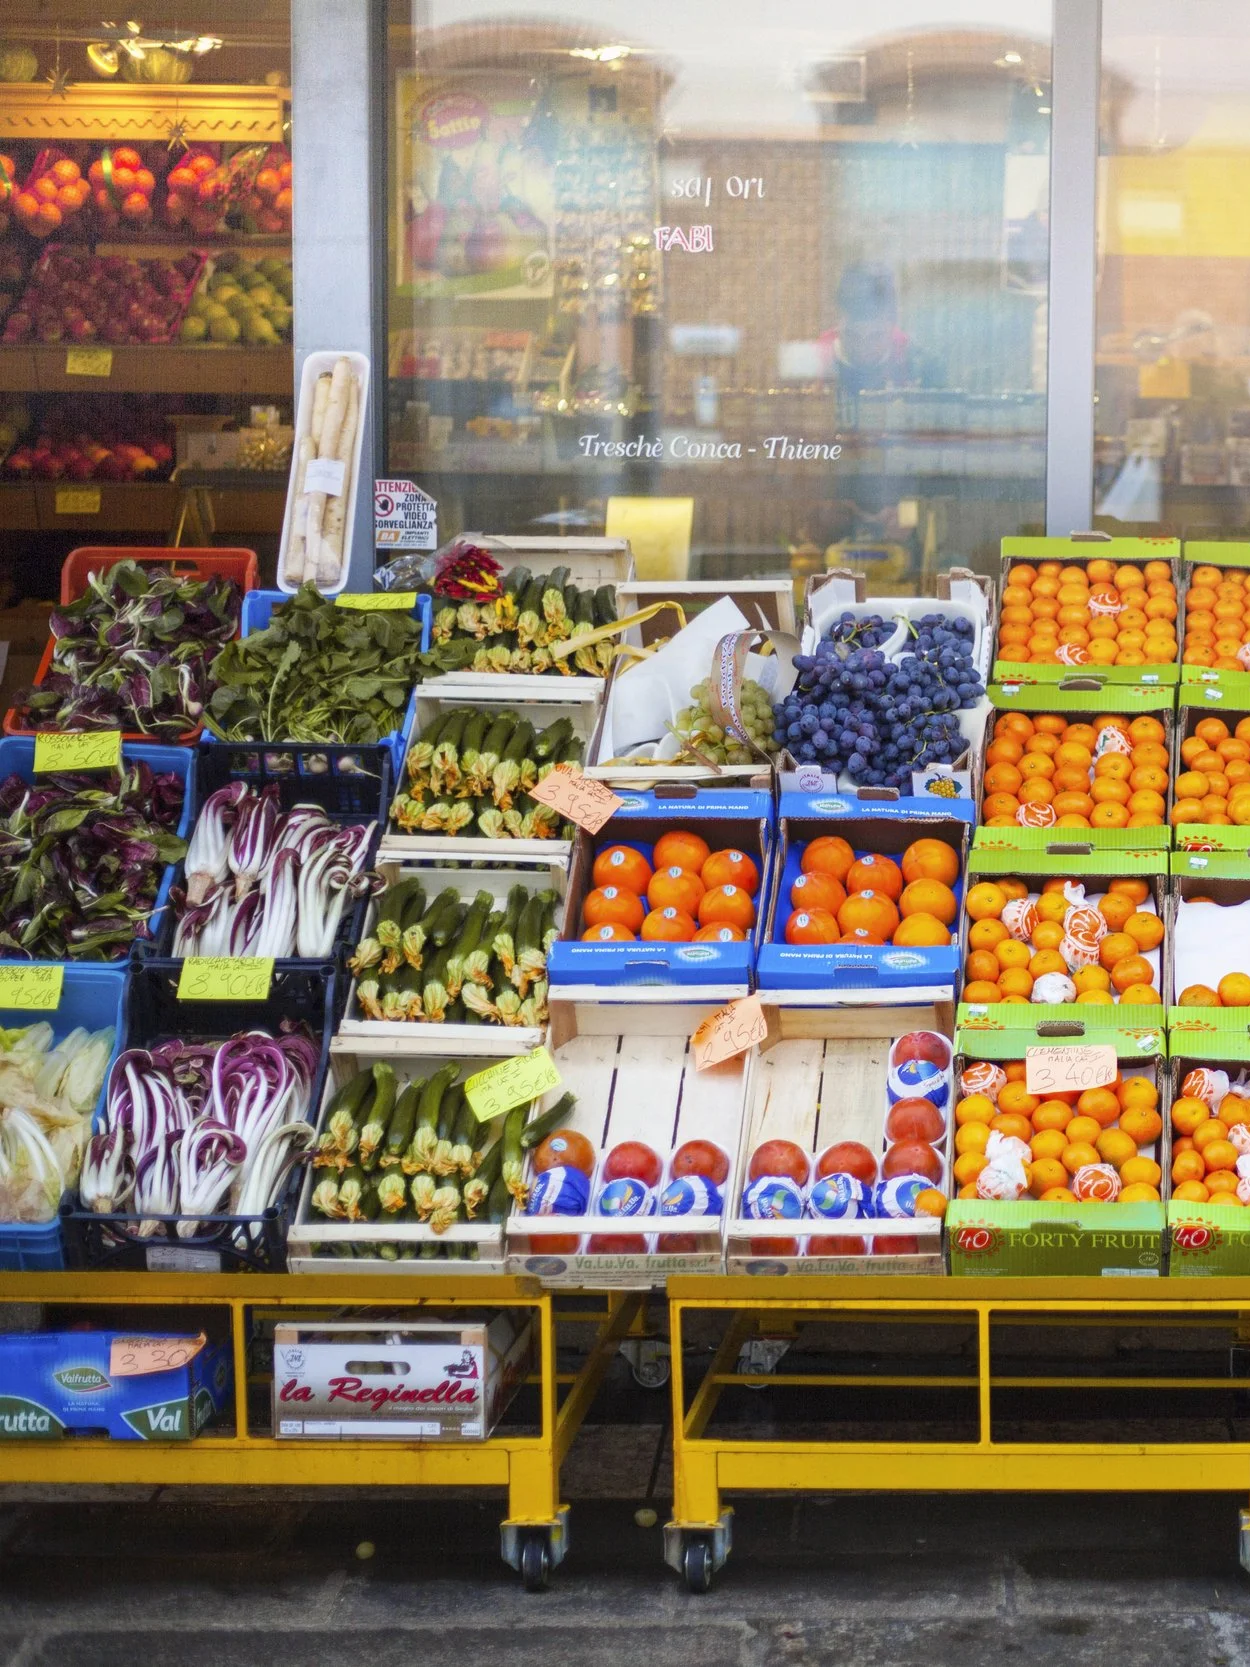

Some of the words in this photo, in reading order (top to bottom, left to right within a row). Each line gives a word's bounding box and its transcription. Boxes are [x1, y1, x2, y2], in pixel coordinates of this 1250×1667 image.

[578, 433, 664, 459] Treschè
[669, 435, 742, 459] Conca
[763, 436, 842, 461] Thiene
[396, 502, 435, 512] PROTETTA
[403, 511, 427, 520] VIDEO
[957, 1230, 990, 1249] 40
[1009, 1232, 1084, 1249] FORTY
[1092, 1233, 1160, 1249] FRUIT
[1175, 1229, 1208, 1247] 40
[61, 1373, 101, 1385] Valfrutta
[279, 1378, 316, 1402] la
[328, 1376, 480, 1412] Reginella
[147, 1407, 181, 1432] Val
